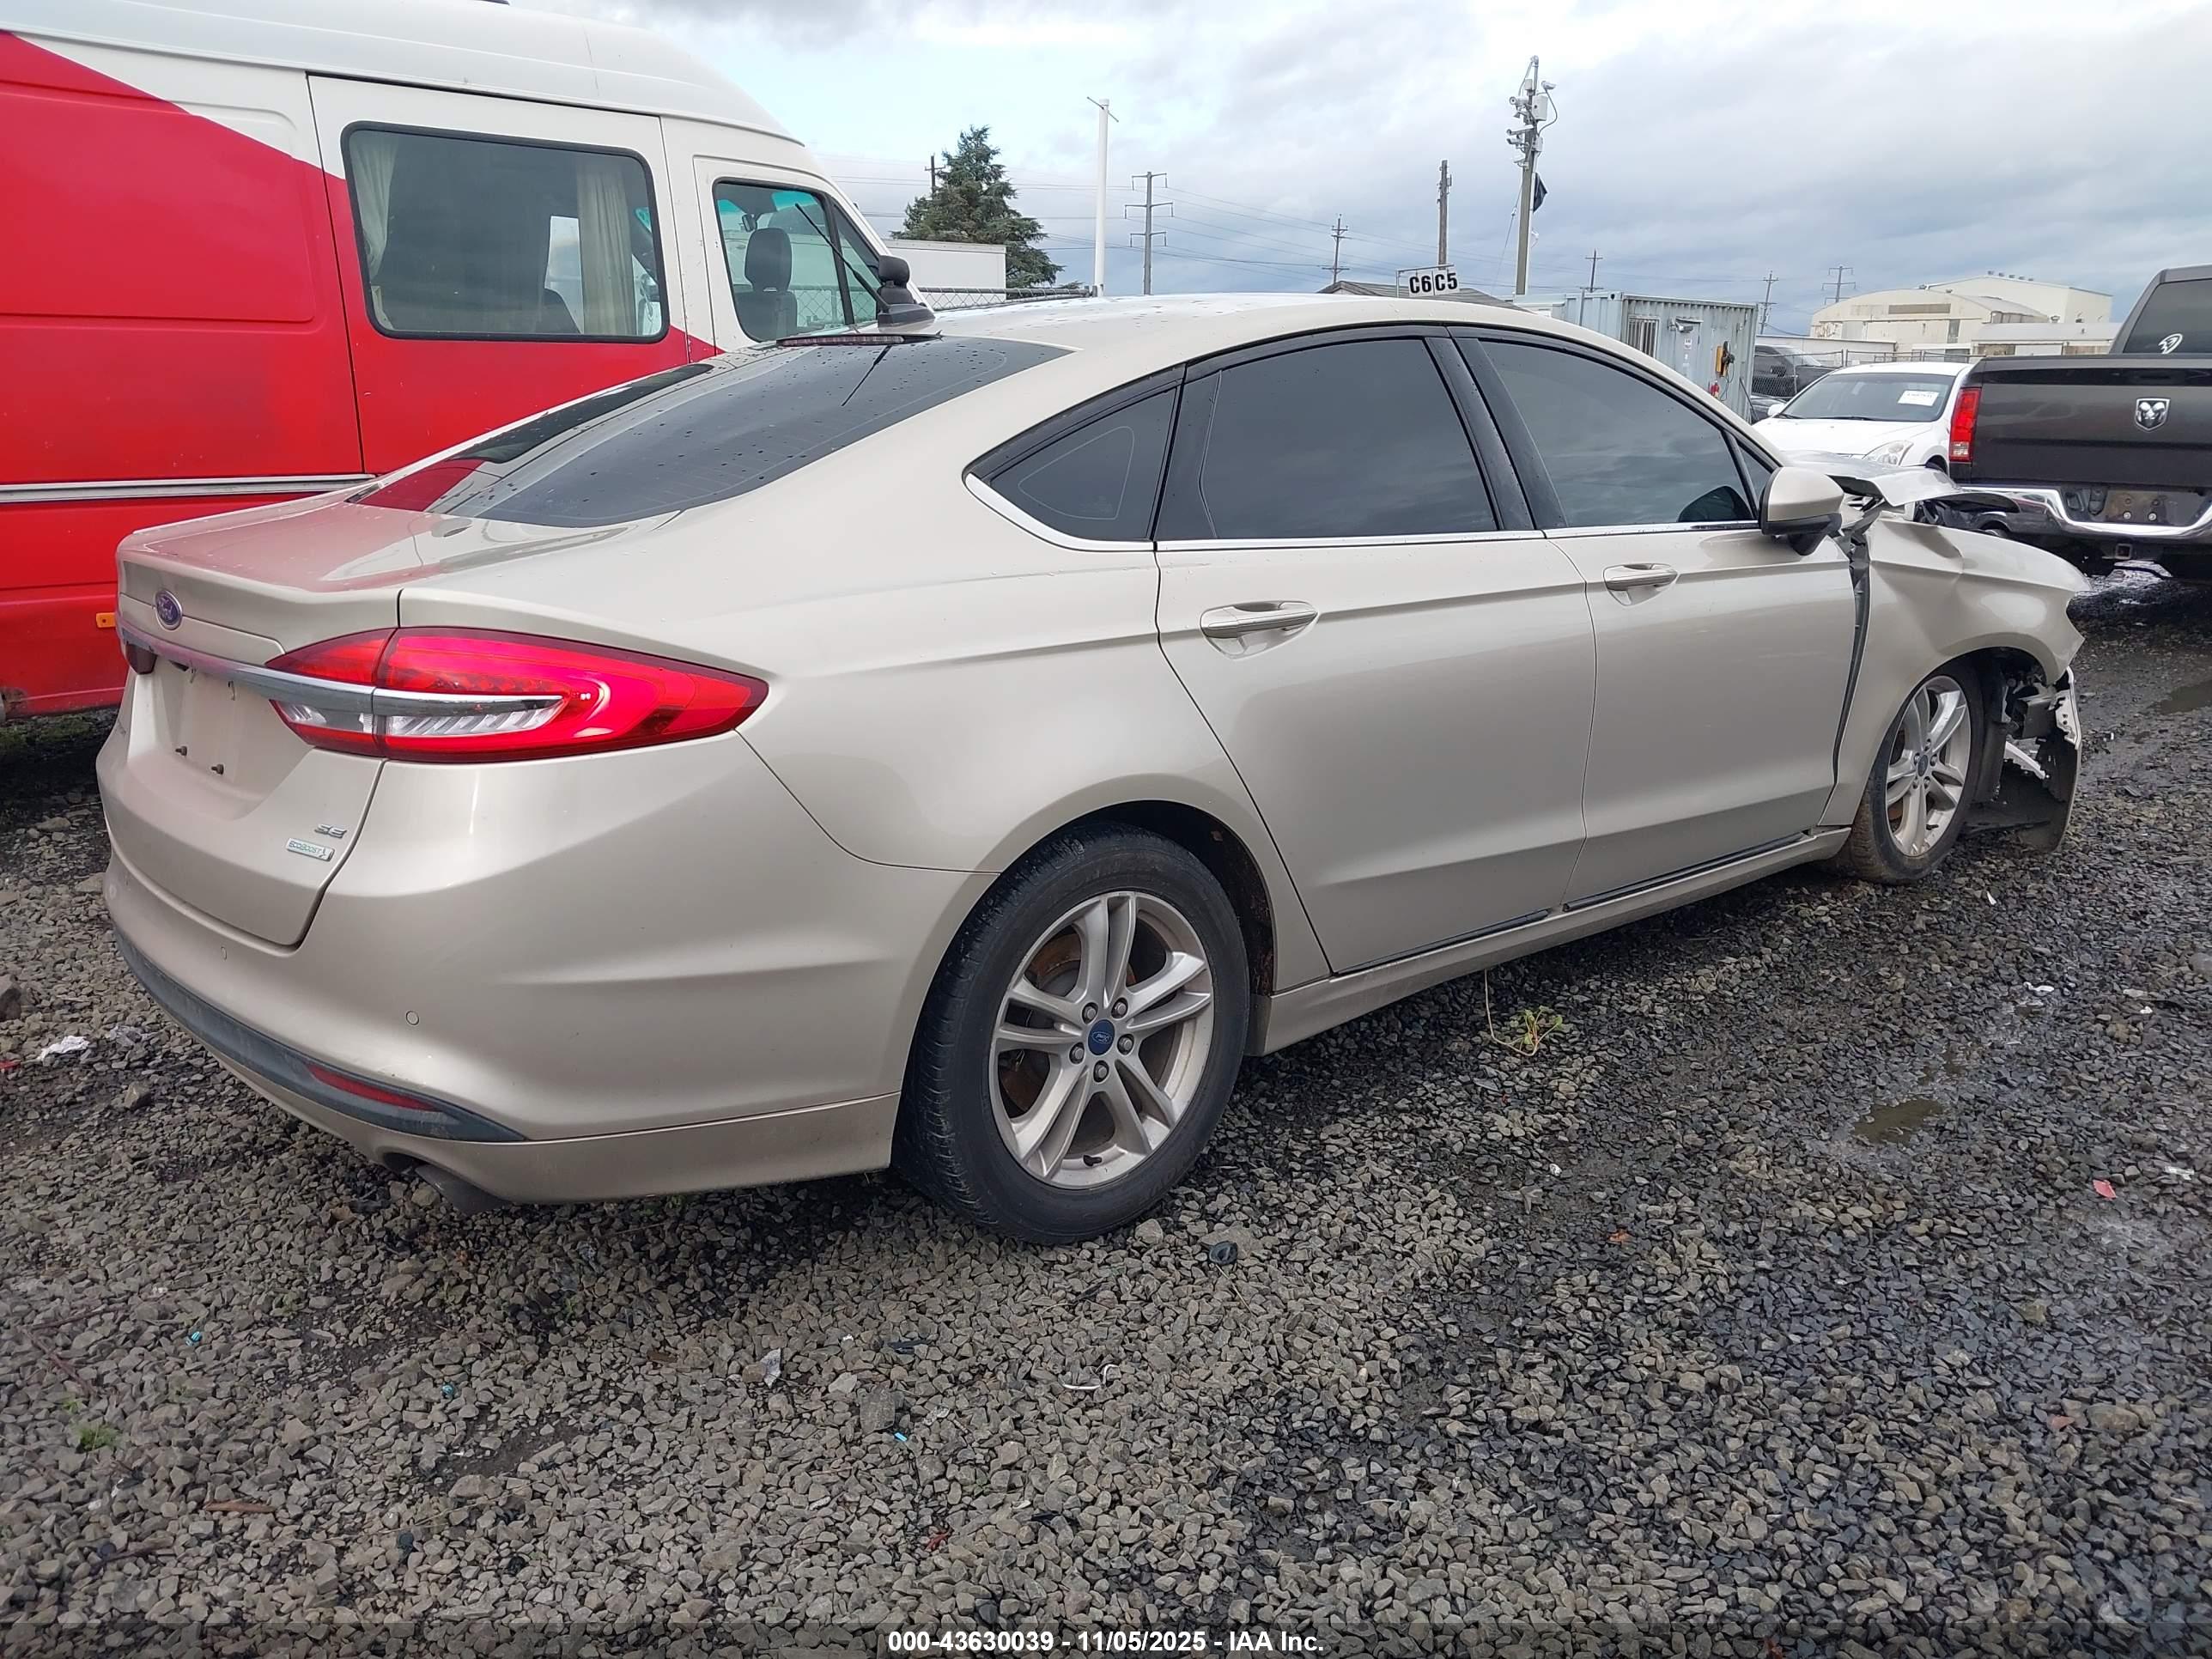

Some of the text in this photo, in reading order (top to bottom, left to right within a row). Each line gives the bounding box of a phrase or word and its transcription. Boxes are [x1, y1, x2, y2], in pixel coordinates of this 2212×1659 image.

[1409, 272, 1458, 294] C6 C5
[314, 823, 348, 839] SE
